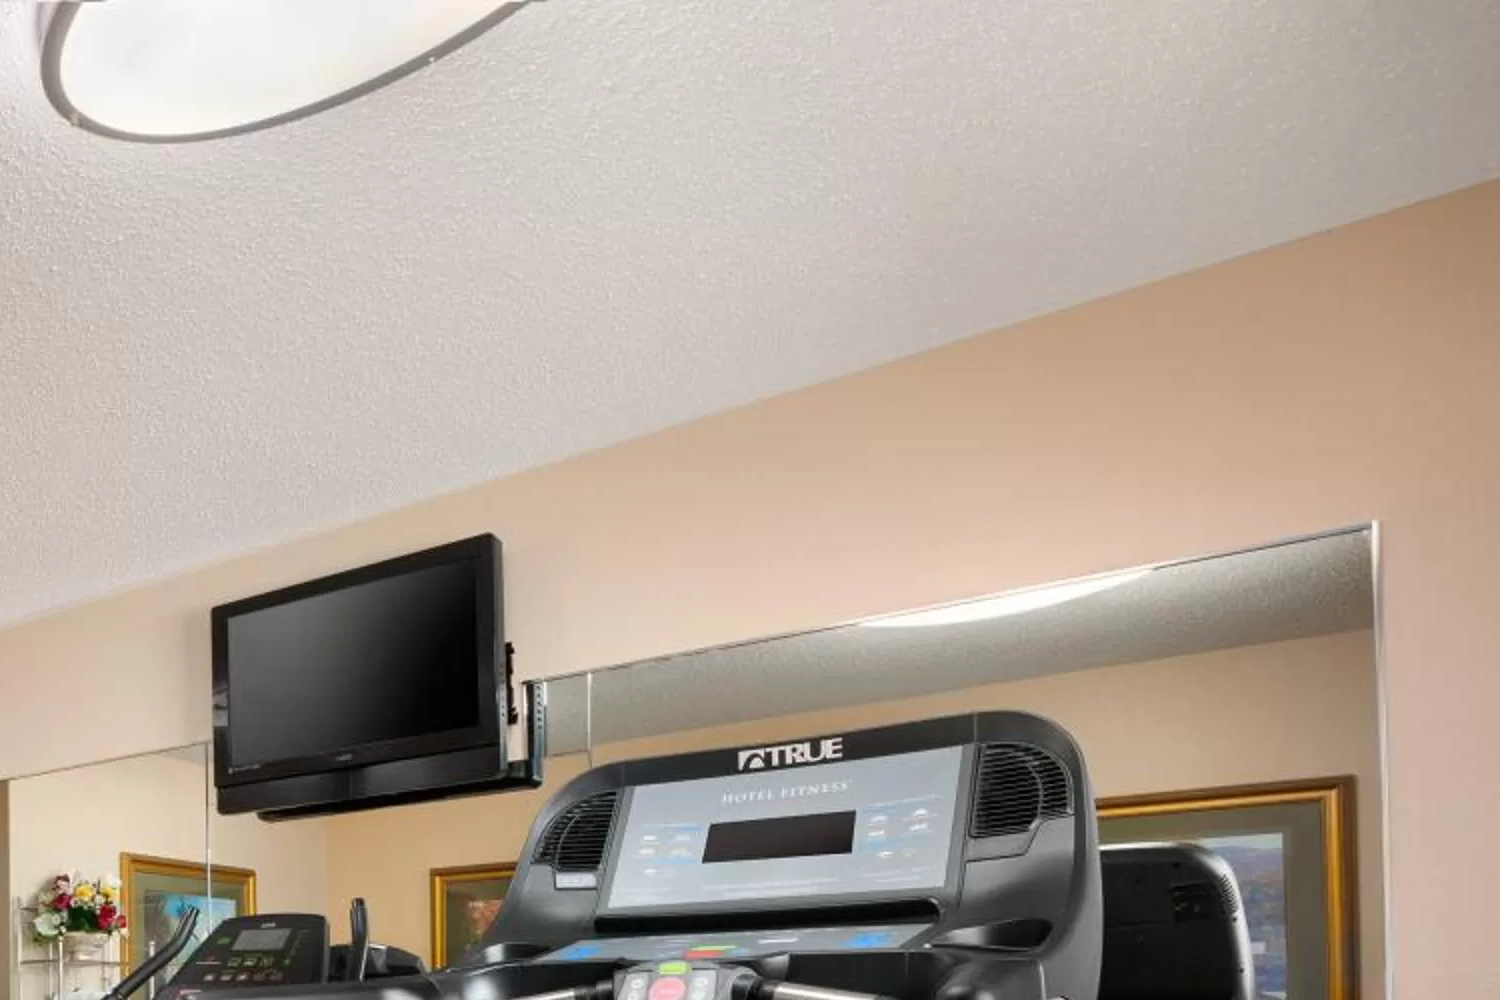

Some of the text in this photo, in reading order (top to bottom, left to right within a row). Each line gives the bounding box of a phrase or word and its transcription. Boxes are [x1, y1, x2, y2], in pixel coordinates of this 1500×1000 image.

[765, 737, 844, 767] TRUE
[721, 780, 849, 805] HOTEL FITNESS
